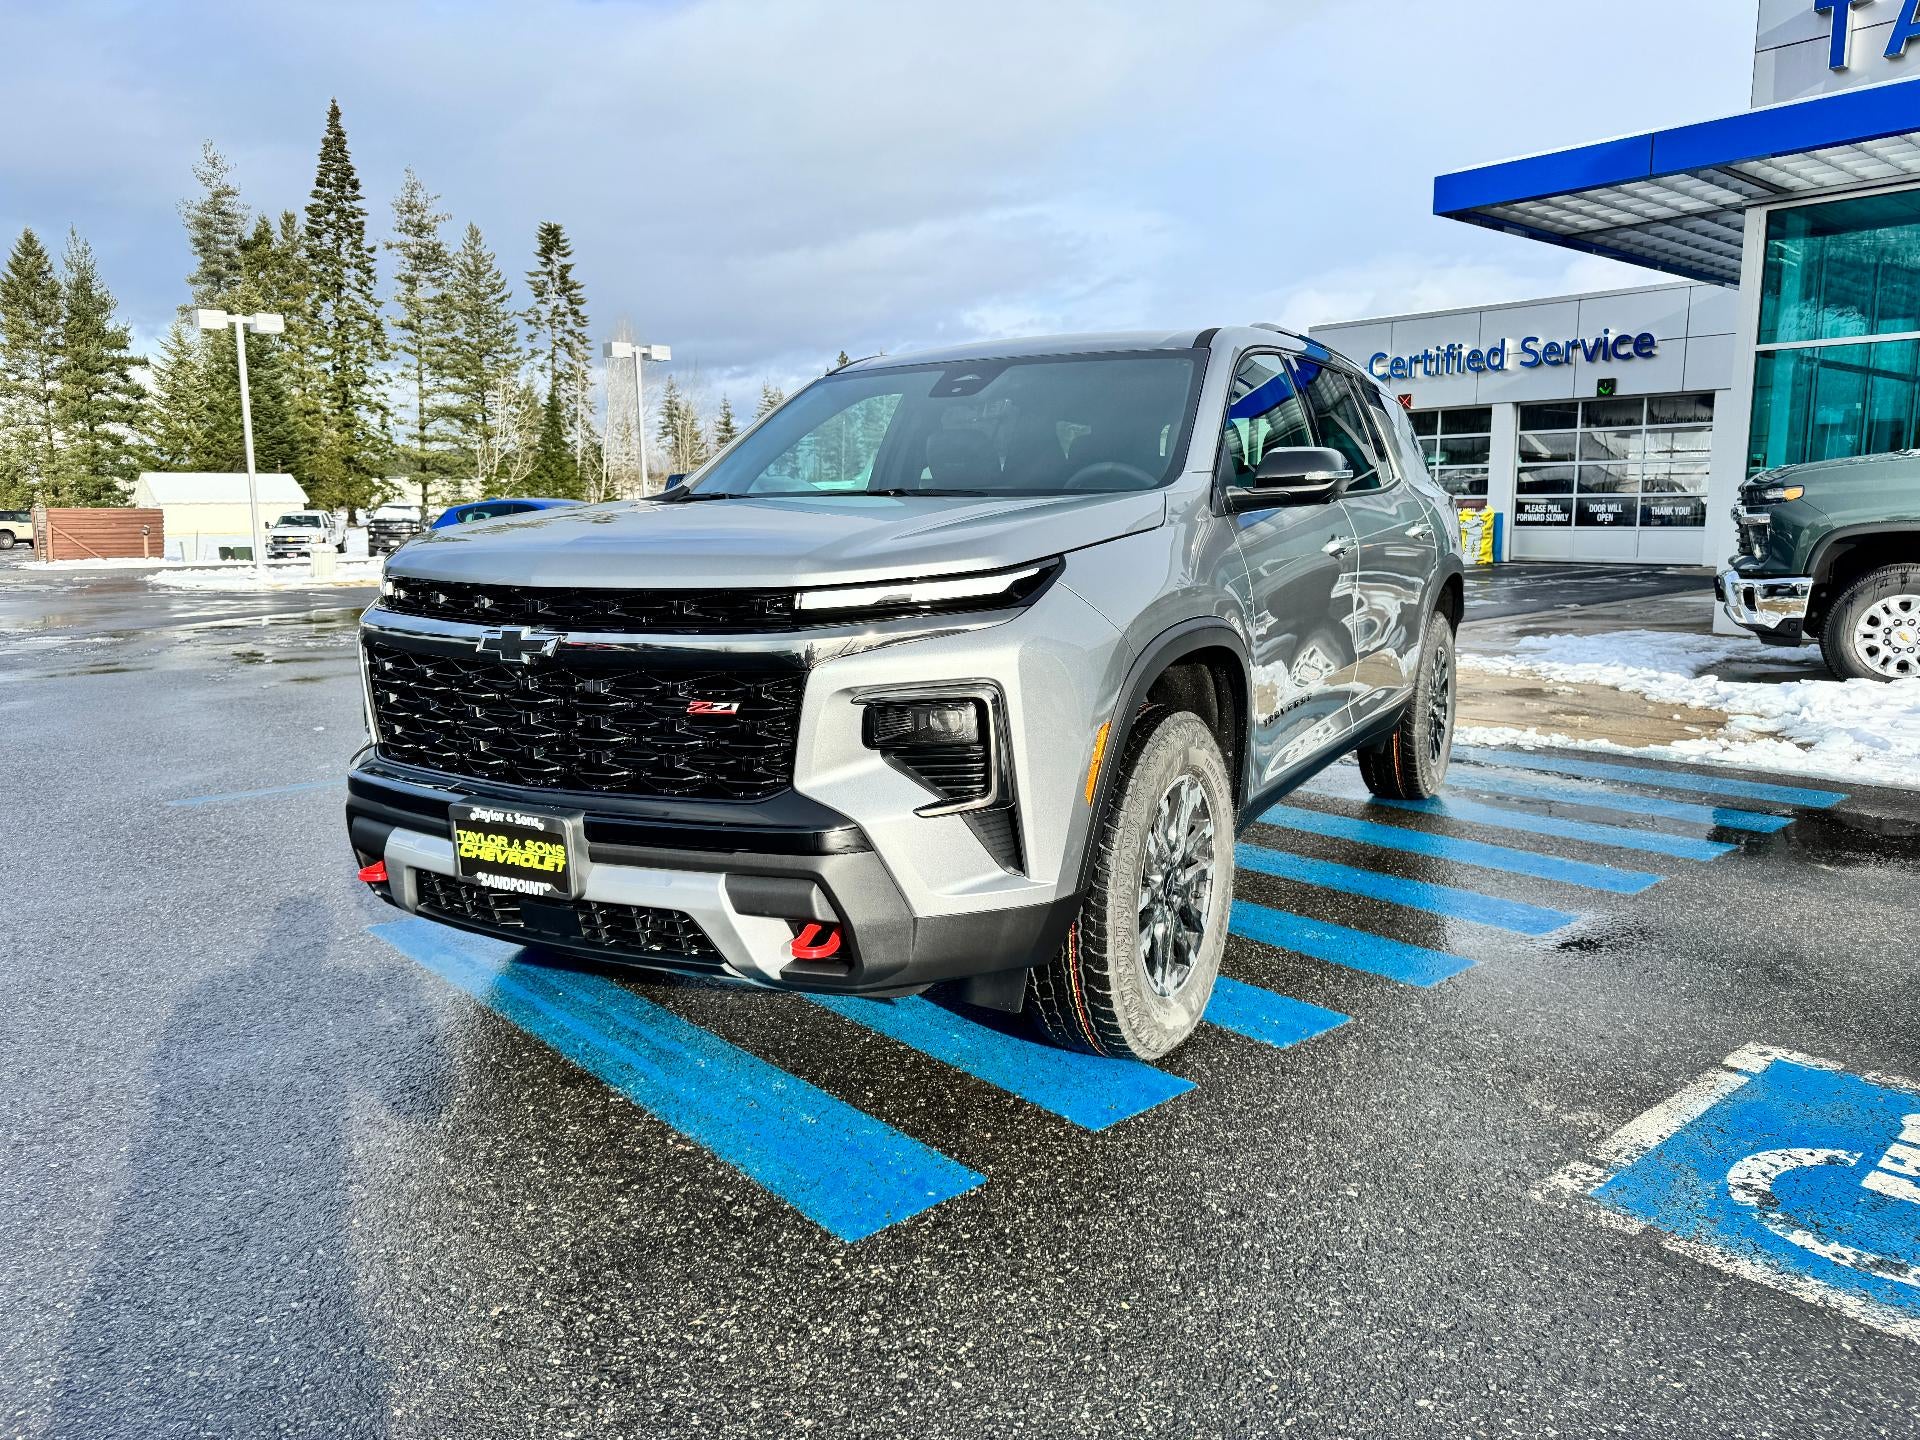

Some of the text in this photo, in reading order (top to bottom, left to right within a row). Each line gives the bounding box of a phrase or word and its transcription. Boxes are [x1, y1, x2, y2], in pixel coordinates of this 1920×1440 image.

[1368, 327, 1656, 382] Certified Service
[1524, 503, 1562, 513] PLEASE PULL
[1589, 503, 1623, 513] DOOR WILL
[1651, 506, 1691, 516] THANK YOU!
[1516, 513, 1569, 522] FORWARD SLOWLY
[1597, 512, 1614, 522] OPEN
[472, 807, 539, 828] Taylor & Sons
[456, 830, 565, 859] TAYLOR & SONS
[460, 844, 566, 873] CHEVROLET
[480, 872, 546, 896] SANDPOINT
